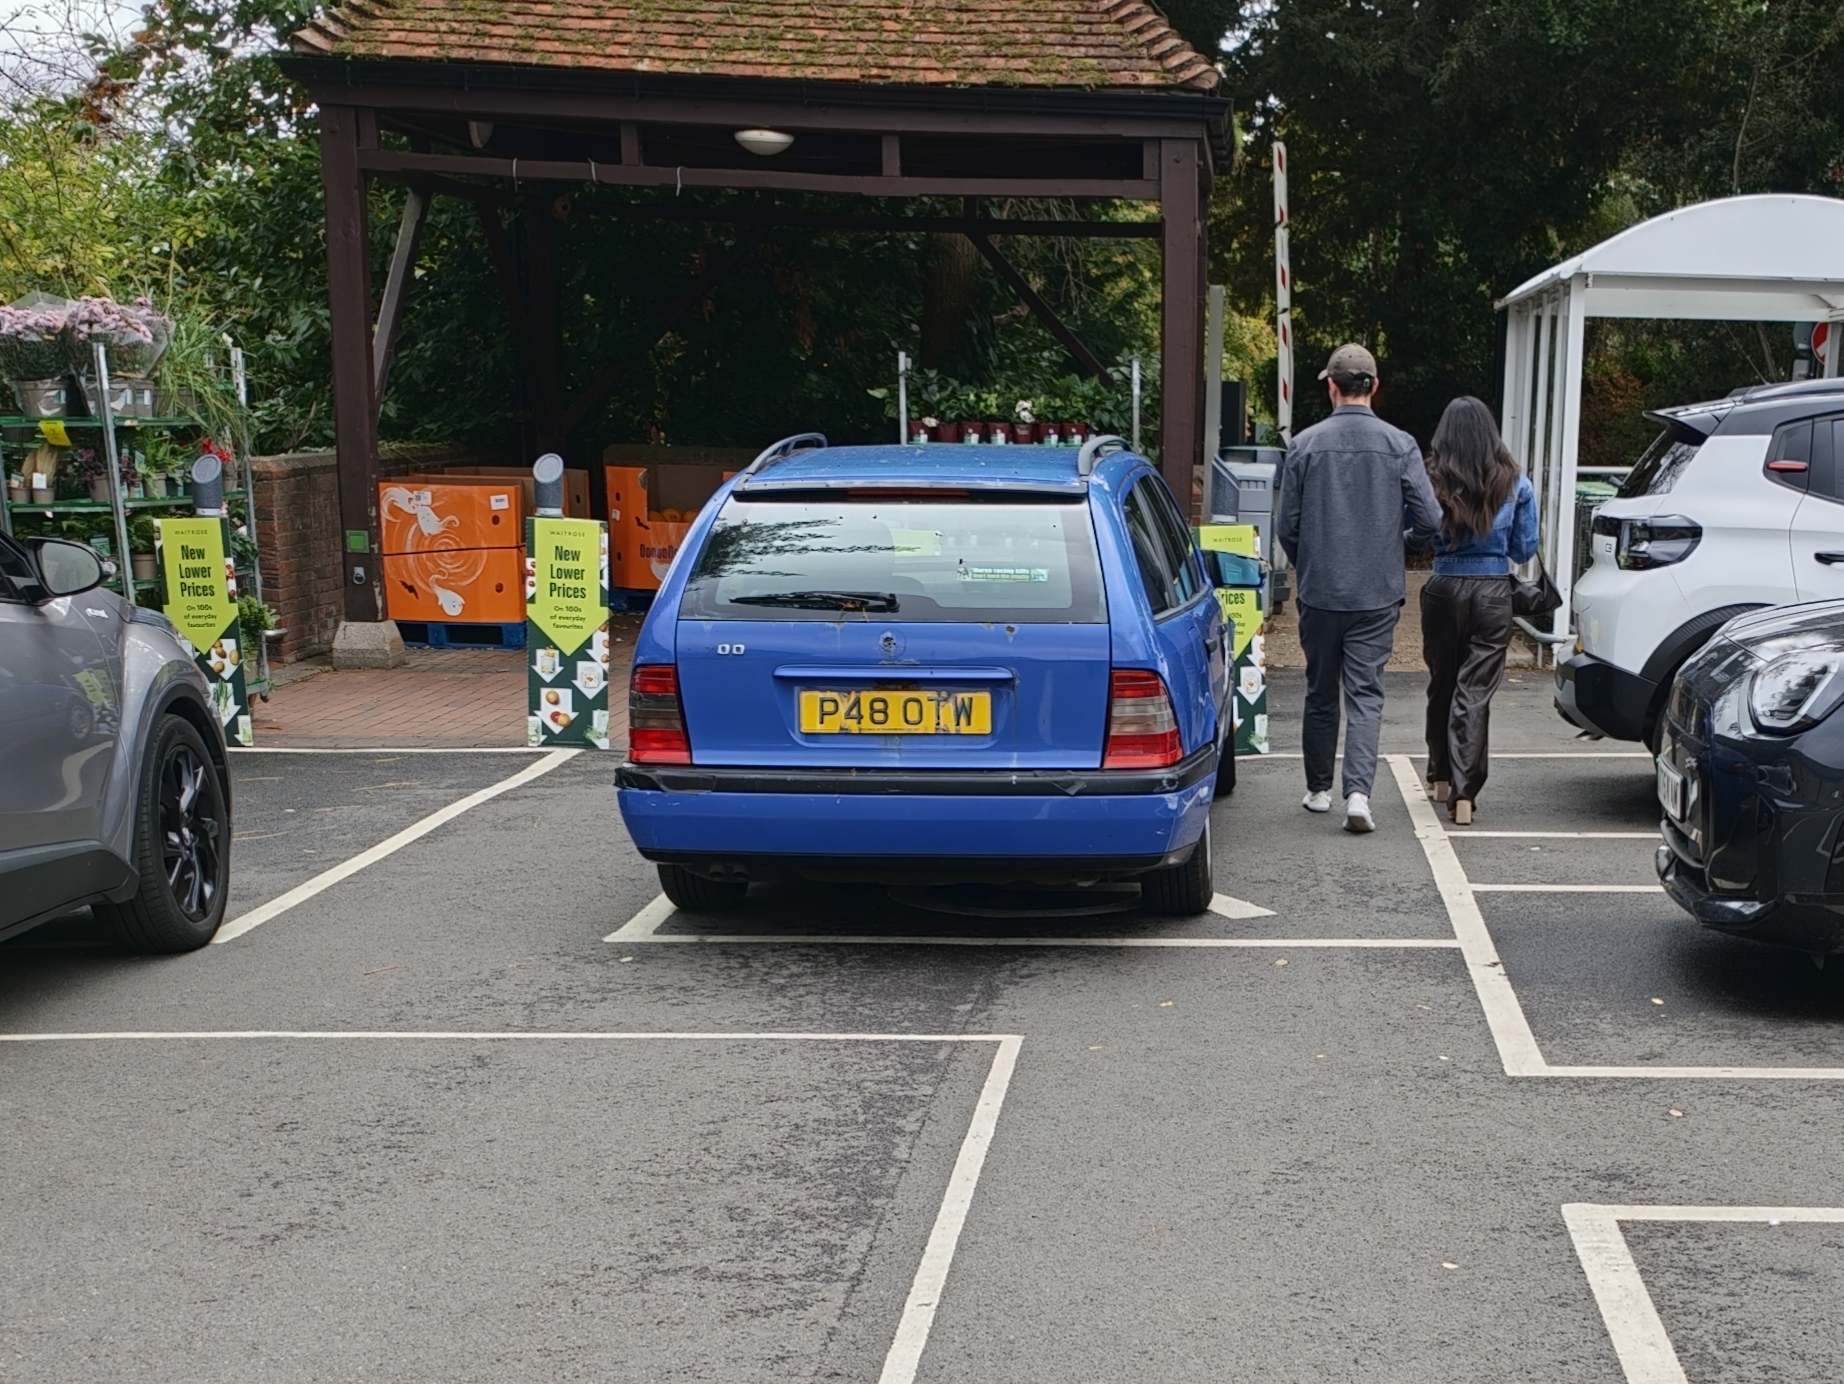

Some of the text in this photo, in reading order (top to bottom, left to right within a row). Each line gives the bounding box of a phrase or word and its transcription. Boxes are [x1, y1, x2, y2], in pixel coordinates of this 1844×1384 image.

[180, 544, 205, 560] New
[554, 545, 581, 561] New
[178, 563, 212, 579] Lower
[550, 563, 585, 580] Lower
[180, 582, 215, 597] Prices
[549, 582, 587, 599] Prices
[1221, 590, 1246, 605] rices
[552, 622, 584, 630] favourites
[818, 696, 974, 726] P48 OTW
